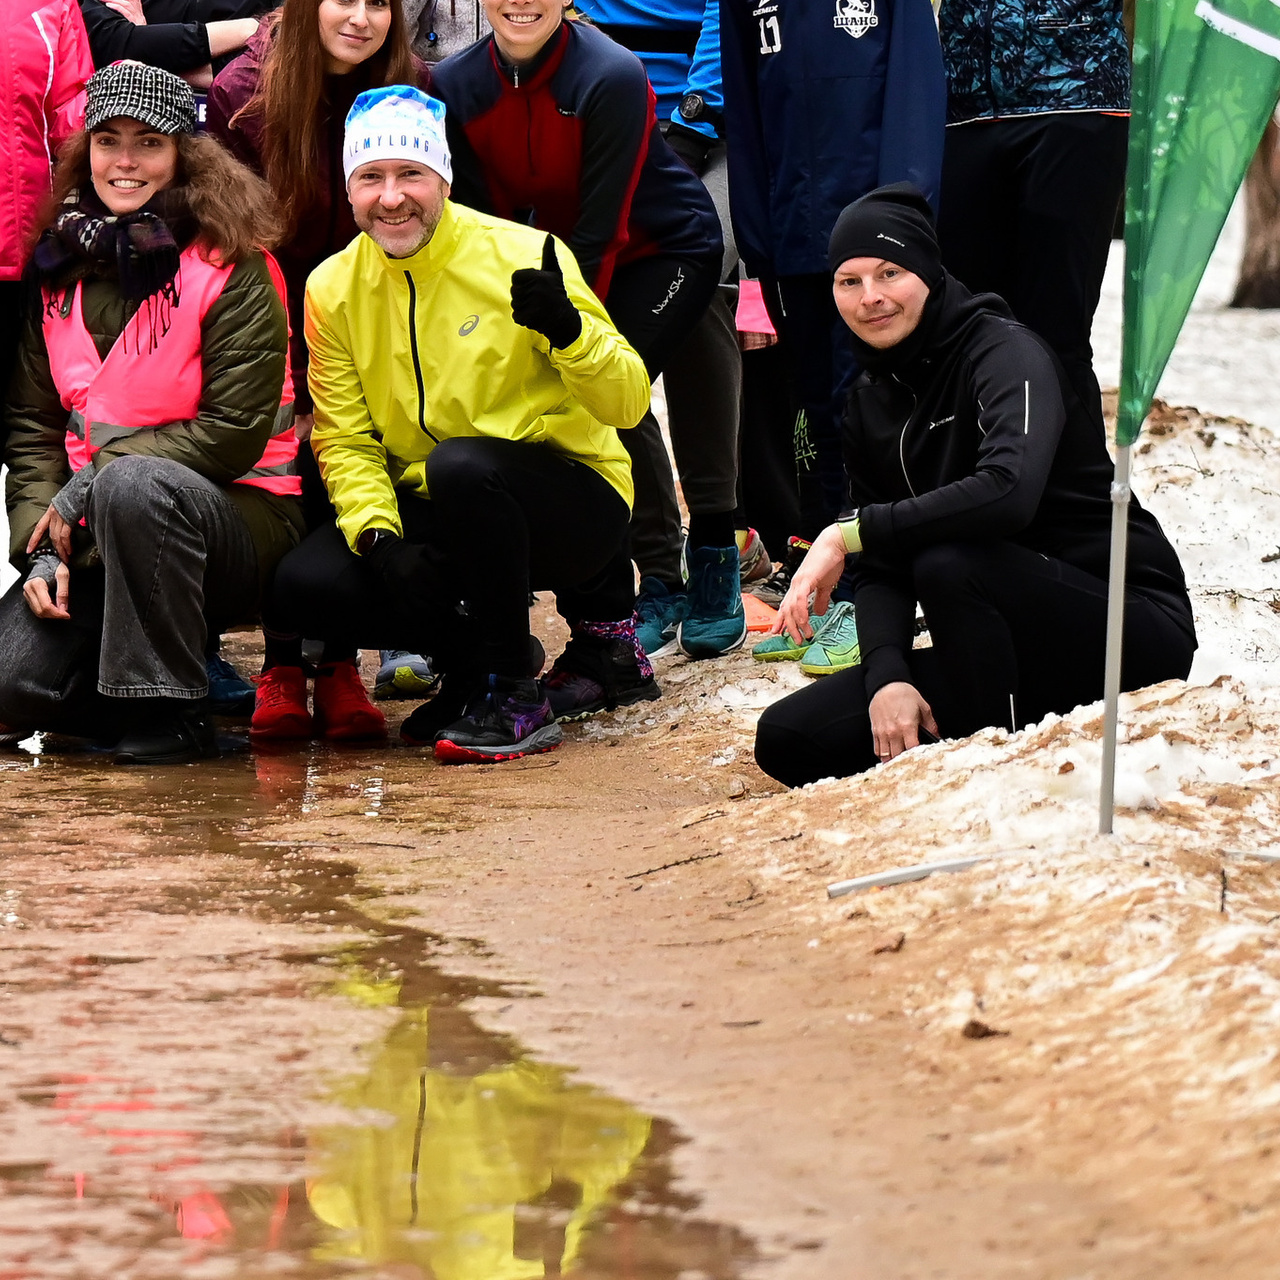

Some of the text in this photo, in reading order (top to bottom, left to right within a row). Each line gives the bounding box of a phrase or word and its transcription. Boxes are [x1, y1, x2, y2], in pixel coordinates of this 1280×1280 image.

[752, 4, 779, 17] DEMIX
[835, 15, 878, 27] ШАНС
[759, 15, 782, 55] 11
